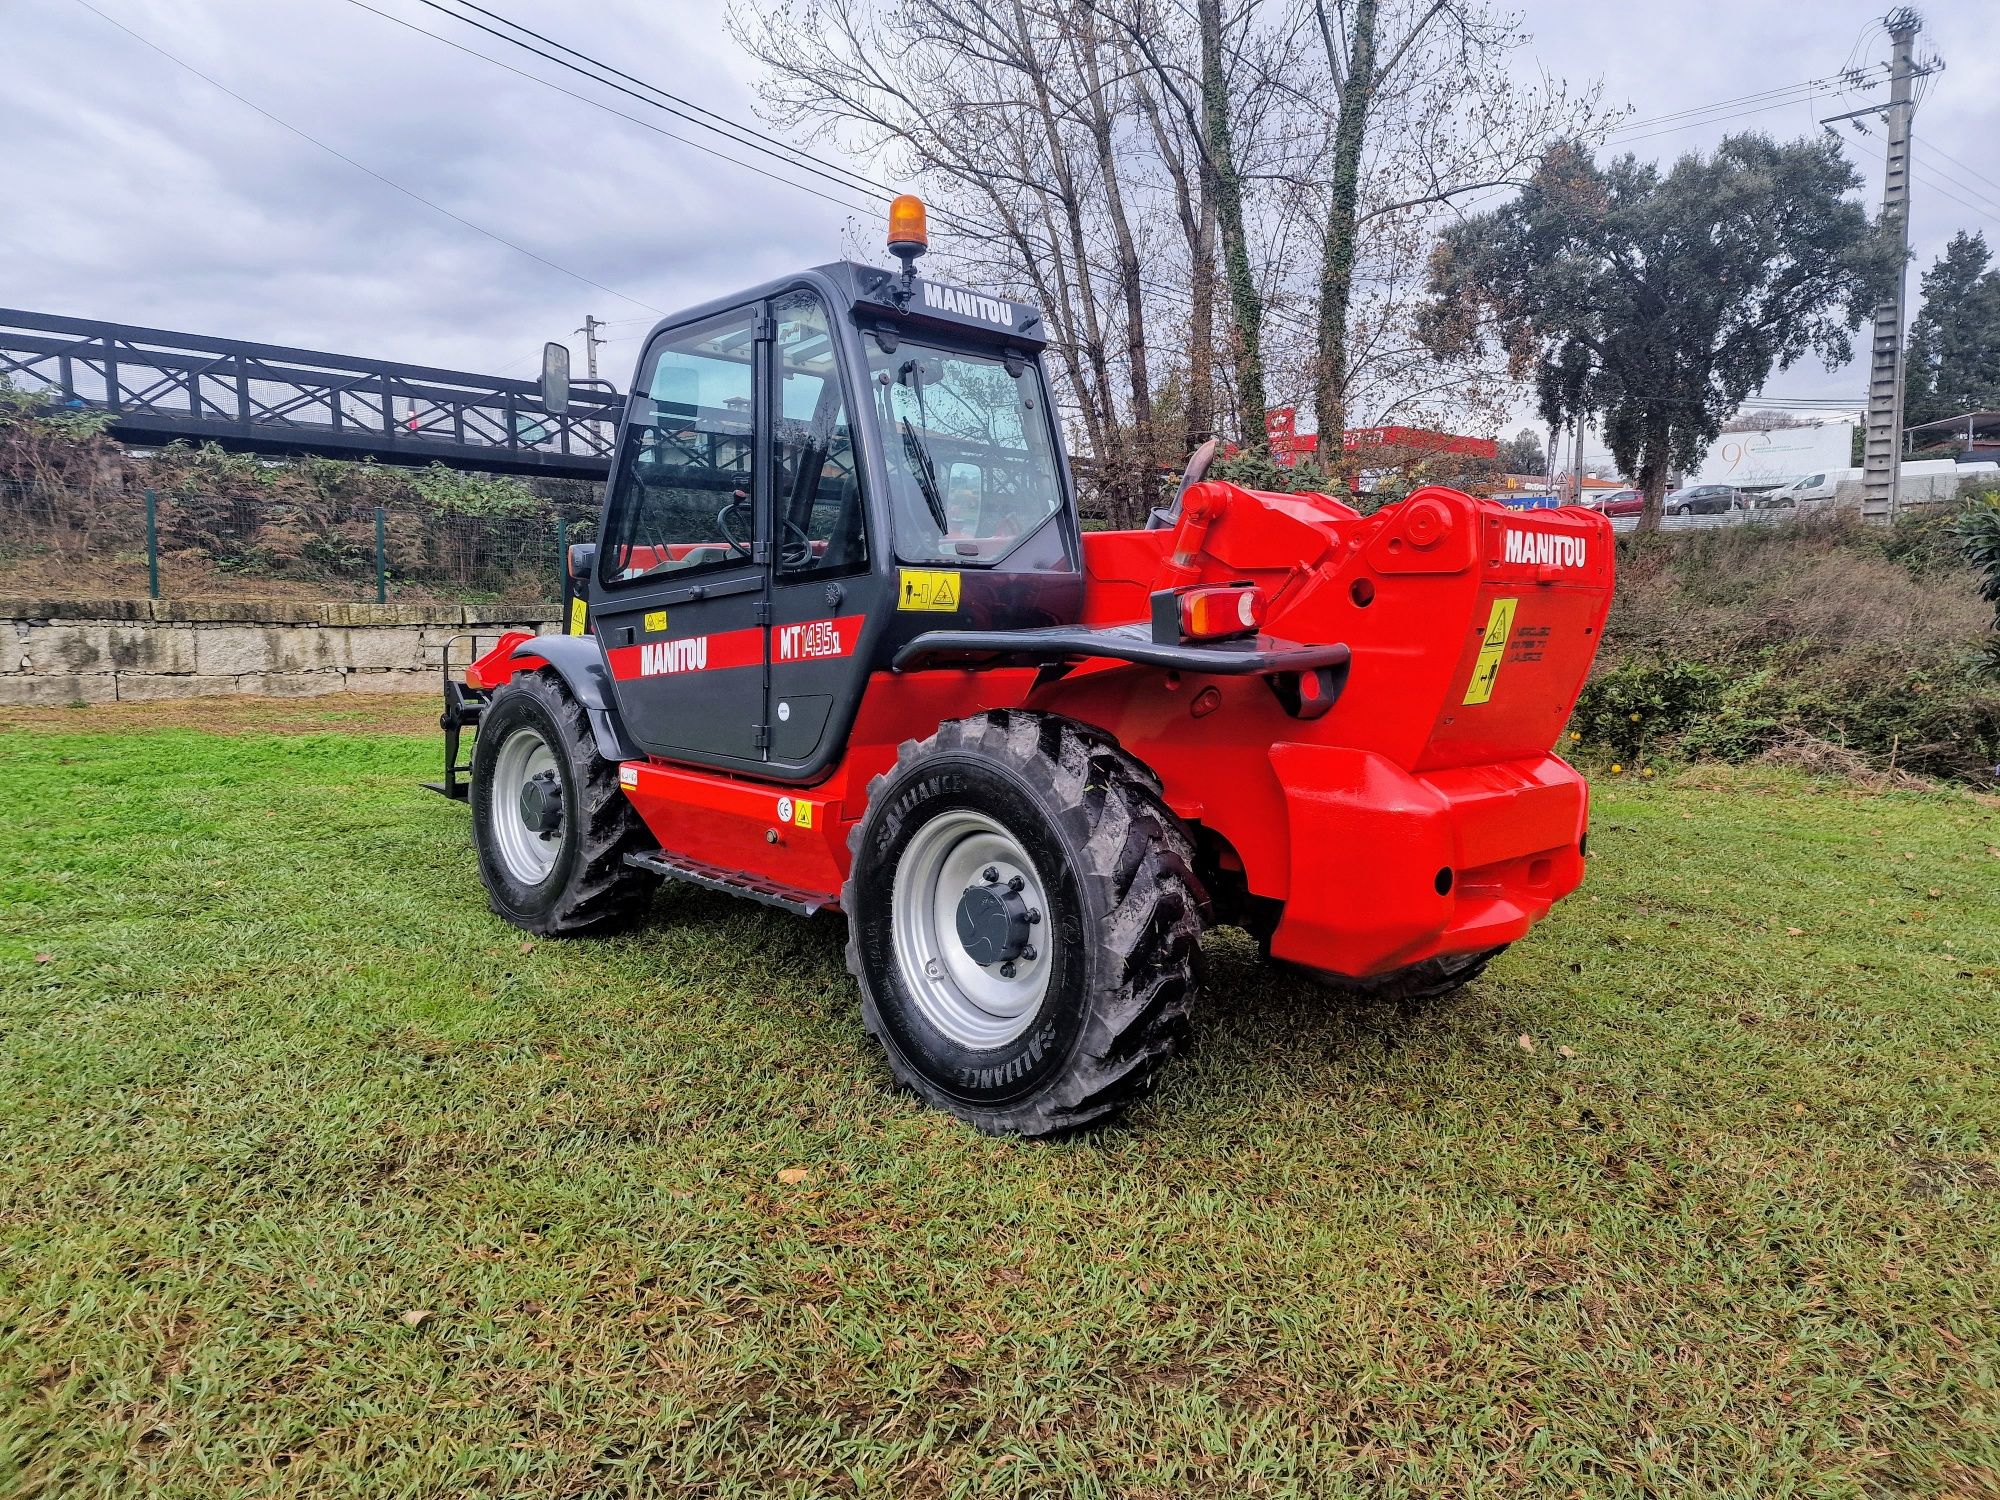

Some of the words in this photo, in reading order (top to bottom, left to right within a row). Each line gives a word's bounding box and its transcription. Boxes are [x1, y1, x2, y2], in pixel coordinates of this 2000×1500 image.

[923, 282, 1013, 327] MANITOU
[1505, 529, 1586, 568] MANITOU
[641, 636, 708, 677] MANITOU
[885, 773, 962, 839] ALLIANCE
